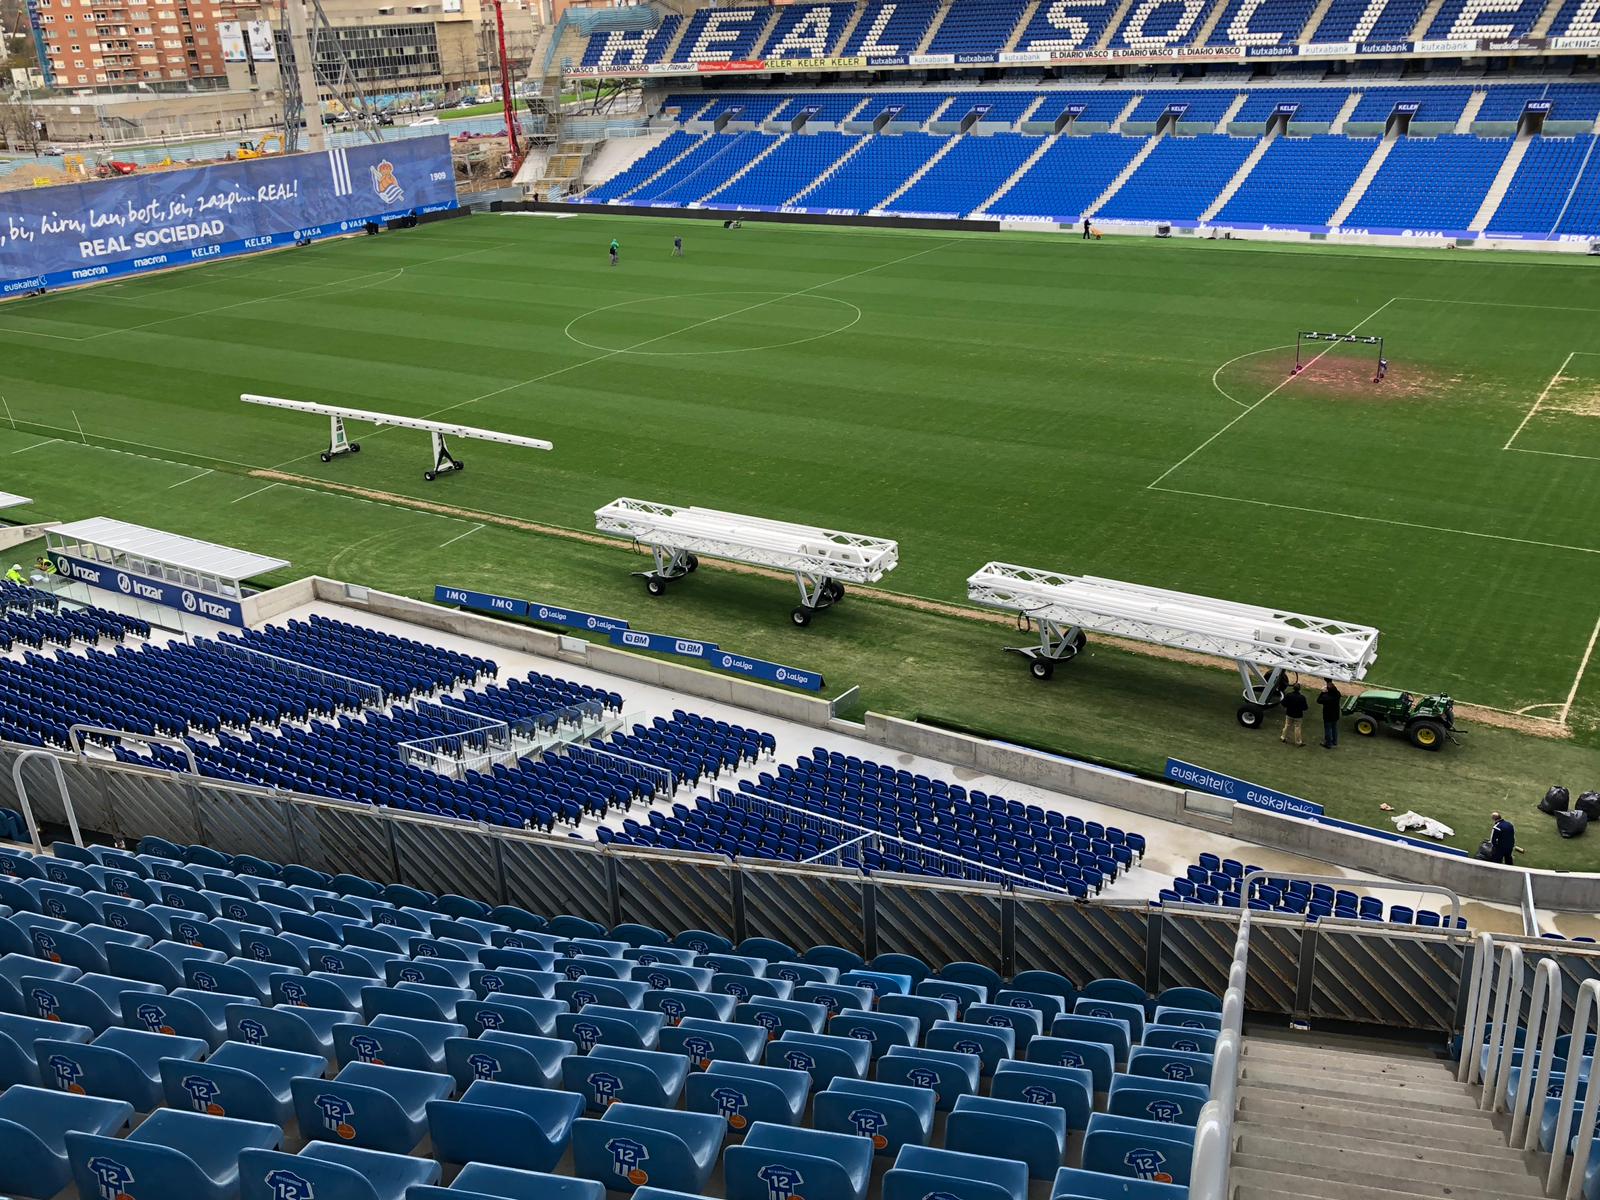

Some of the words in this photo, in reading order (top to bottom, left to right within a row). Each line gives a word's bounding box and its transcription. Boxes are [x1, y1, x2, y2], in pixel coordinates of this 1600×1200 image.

[1216, 47, 1240, 55] VASCO
[1251, 46, 1293, 56] kutxabank
[1362, 43, 1407, 52] kutxabank
[1422, 42, 1468, 50] kutxabank
[764, 60, 792, 68] KELER
[798, 59, 825, 67] KELER
[832, 58, 860, 66] KELER
[871, 56, 905, 64] kutxabank
[959, 54, 994, 62] kutxabank
[430, 172, 446, 182] 1909
[9, 217, 34, 242] bi,
[258, 179, 298, 202] REAL!
[348, 219, 367, 228] VASA
[302, 227, 322, 236] VASA
[80, 236, 132, 258] REAL
[134, 220, 224, 248] SOCIEDAD
[244, 236, 272, 248] KELER
[191, 244, 221, 258] KELER
[134, 254, 168, 268] macron
[72, 265, 108, 280] macron
[4, 278, 40, 292] euskaltel
[446, 590, 468, 602] IMQ
[492, 598, 513, 610] IMQ
[548, 610, 566, 620] LaLiga
[634, 635, 648, 644] BM
[687, 644, 701, 654] BM
[733, 658, 753, 670] LaLiga
[787, 672, 808, 684] LaLiga
[1171, 766, 1224, 792] euskaltel
[183, 928, 194, 938] 12
[40, 938, 51, 949] 12
[326, 962, 338, 970] 12
[199, 978, 210, 989] 12
[486, 980, 498, 991] 12
[652, 978, 664, 988] 12
[287, 988, 299, 998] 12
[730, 988, 742, 998] 12
[39, 996, 51, 1009] 12
[666, 1004, 678, 1014] 12
[144, 1012, 159, 1024] 12
[482, 1017, 495, 1027] 12
[762, 1018, 774, 1028] 12
[245, 1028, 258, 1040] 12
[580, 1030, 594, 1040] 12
[360, 1043, 373, 1055] 12
[691, 1044, 704, 1055] 12
[476, 1062, 490, 1074] 12
[792, 1058, 806, 1070] 12
[58, 1064, 72, 1078] 12
[1172, 1068, 1184, 1079] 12
[598, 1080, 612, 1092] 12
[916, 1075, 930, 1086] 12
[192, 1086, 208, 1098] 12
[721, 1096, 736, 1108] 12
[1030, 1093, 1046, 1104] 12
[324, 1104, 341, 1118] 12
[1156, 1108, 1171, 1119] 12
[860, 1118, 876, 1130] 12
[618, 1148, 634, 1162] 12
[1136, 1158, 1154, 1170] 12
[100, 1168, 120, 1185] 12
[771, 1176, 790, 1188] 12
[278, 1184, 297, 1200] 12
